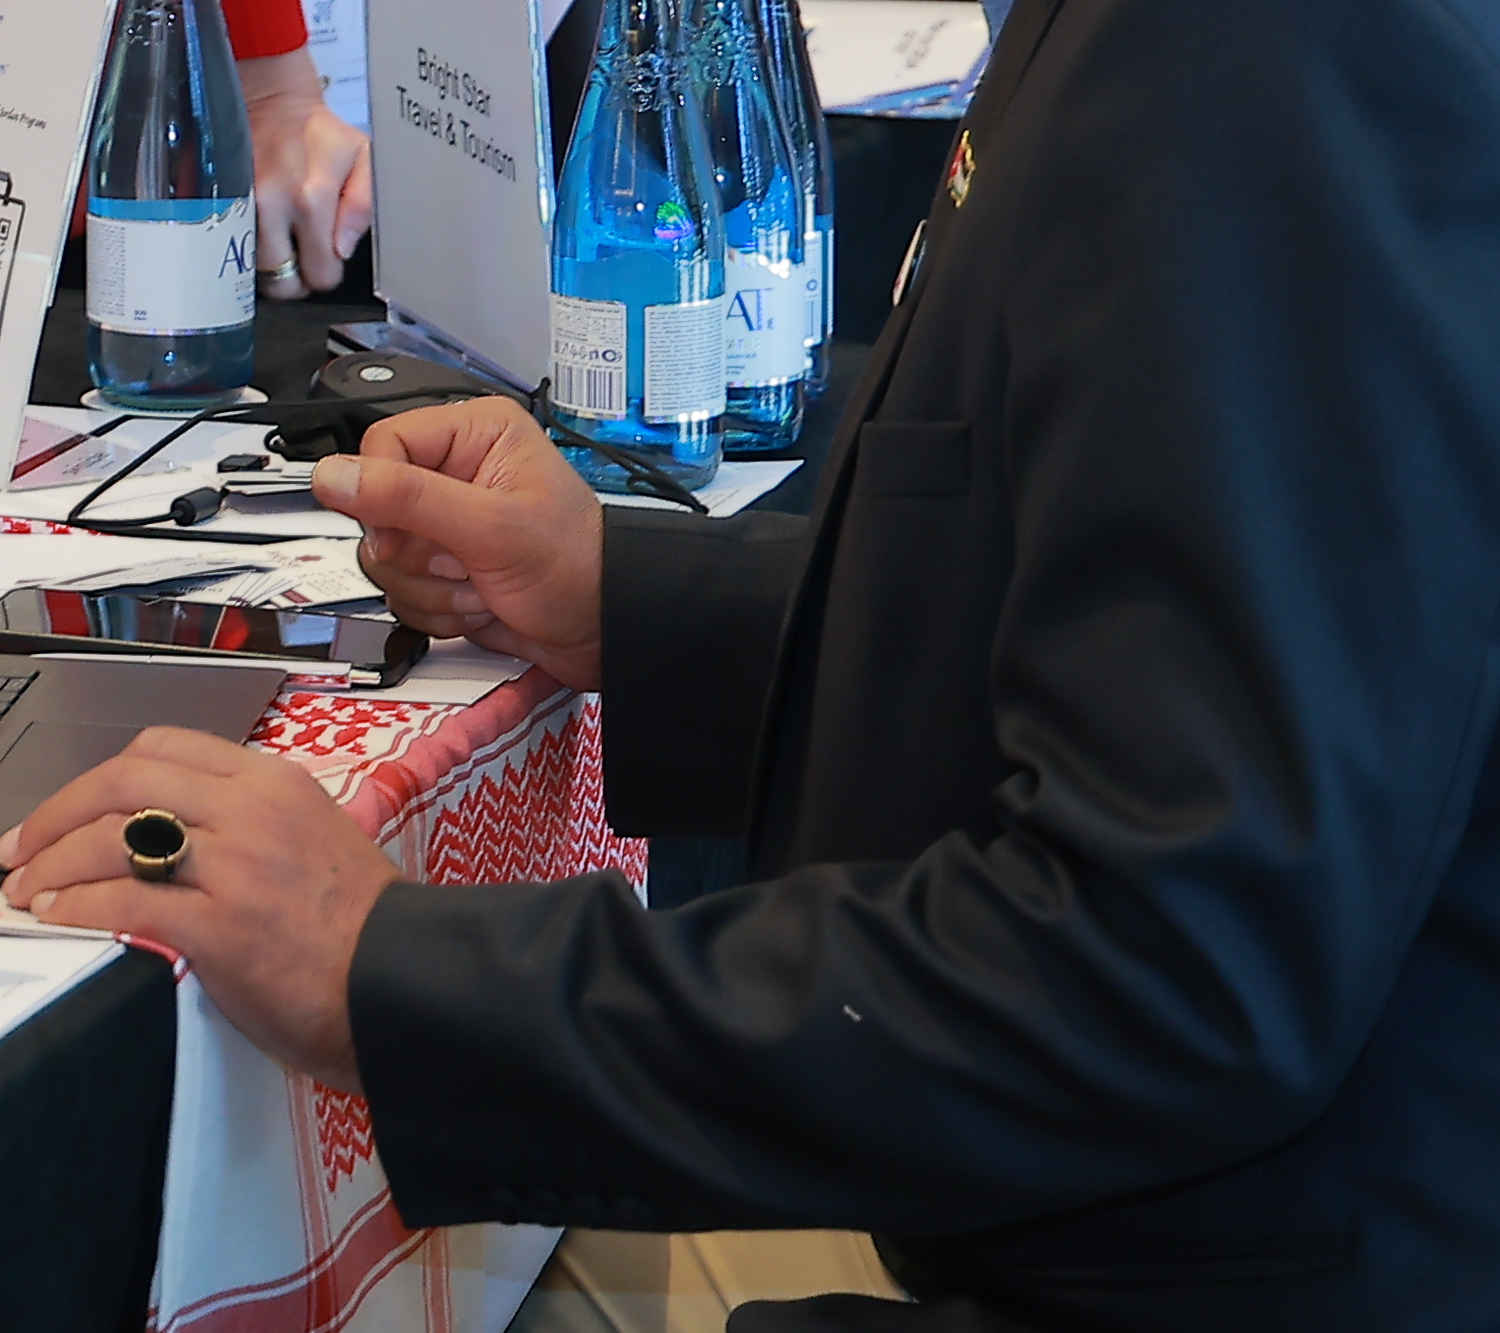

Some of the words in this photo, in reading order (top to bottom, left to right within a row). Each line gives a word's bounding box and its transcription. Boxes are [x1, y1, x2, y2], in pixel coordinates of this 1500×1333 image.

[418, 47, 460, 100] Bright
[462, 73, 490, 117] Star
[396, 85, 443, 138] Travel
[446, 112, 457, 147] &
[460, 119, 516, 182] Tourism
